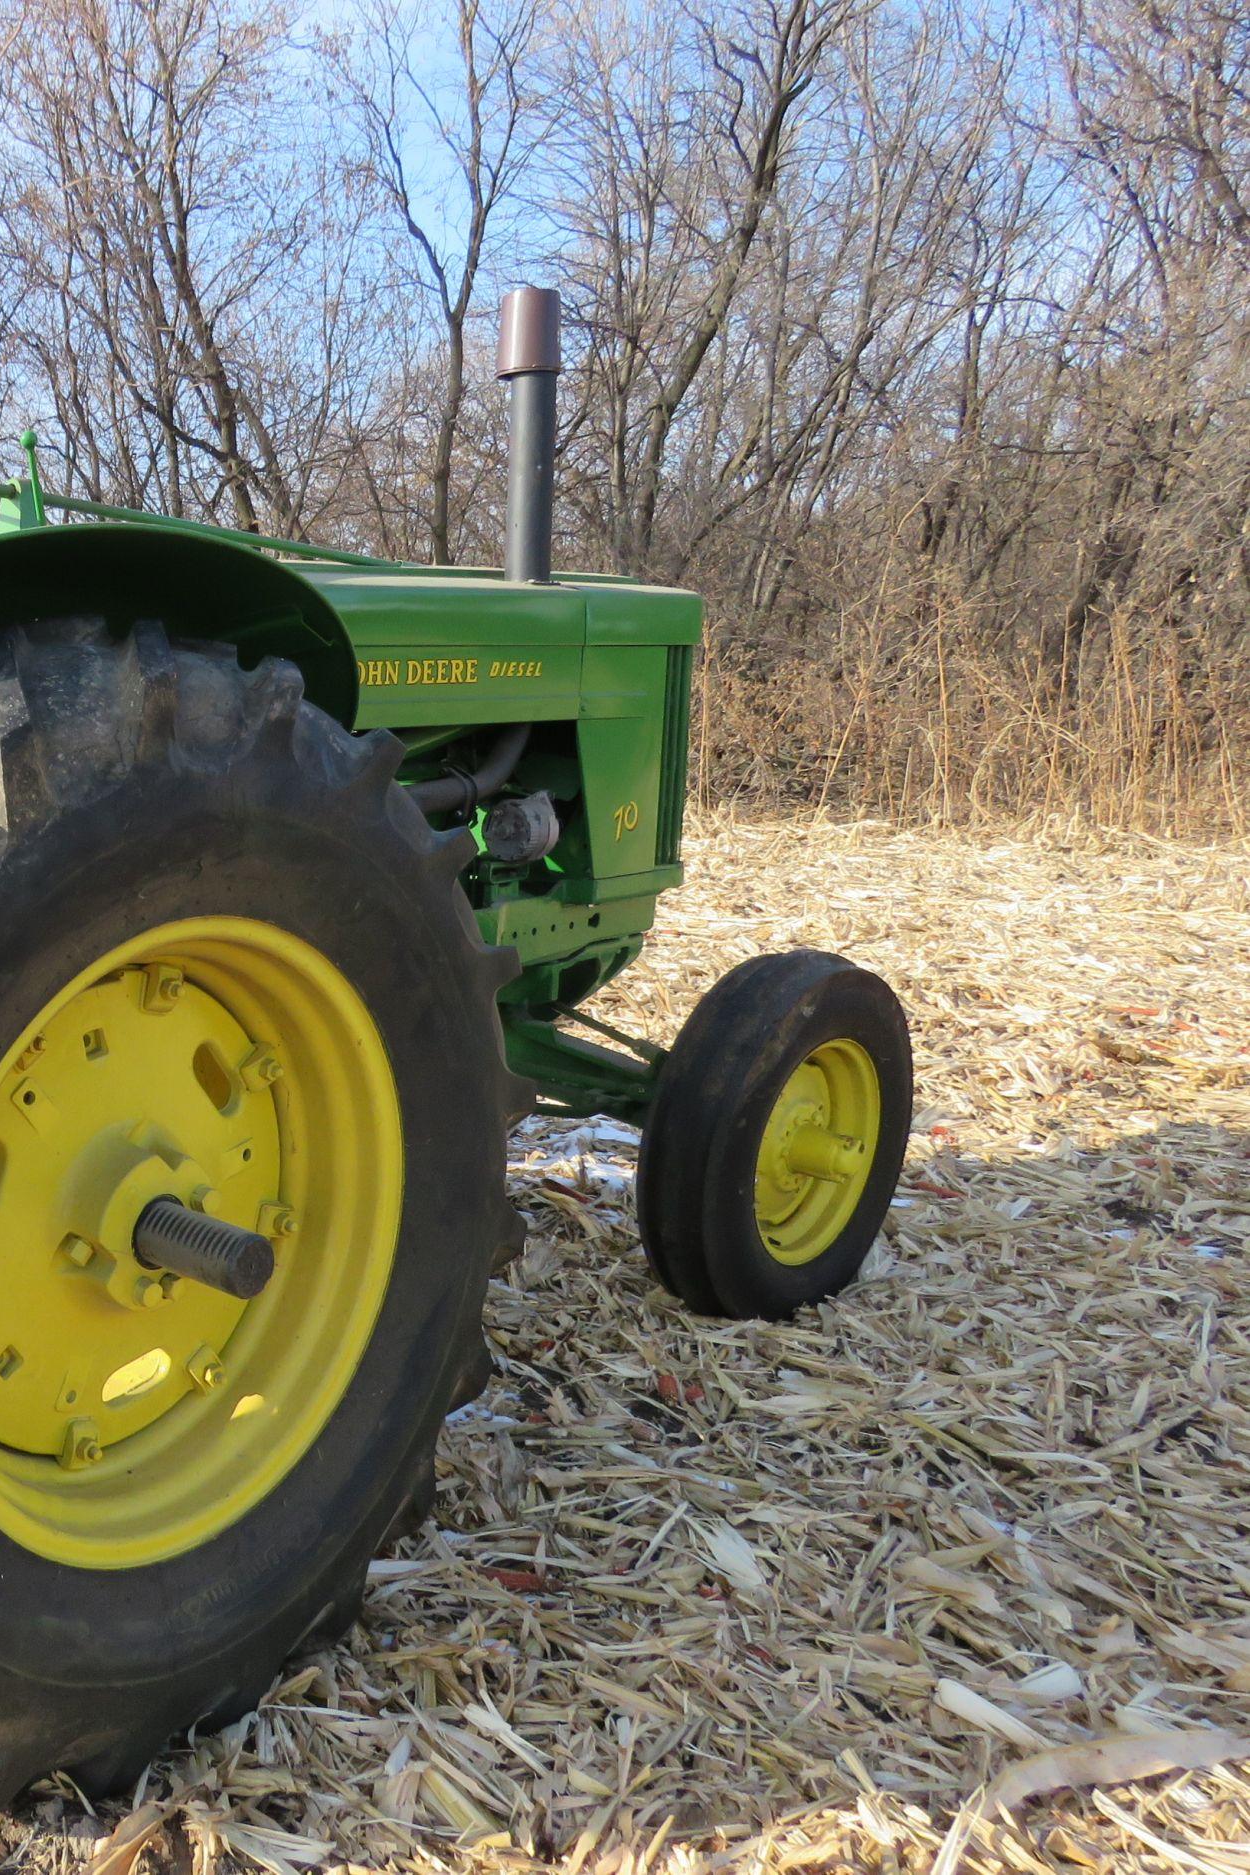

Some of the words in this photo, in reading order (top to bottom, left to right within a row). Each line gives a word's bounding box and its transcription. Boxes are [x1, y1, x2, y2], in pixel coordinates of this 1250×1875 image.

[357, 660, 400, 686] OHN
[406, 659, 478, 685] DEERE
[489, 661, 543, 678] DIESEL
[613, 800, 639, 843] 70
